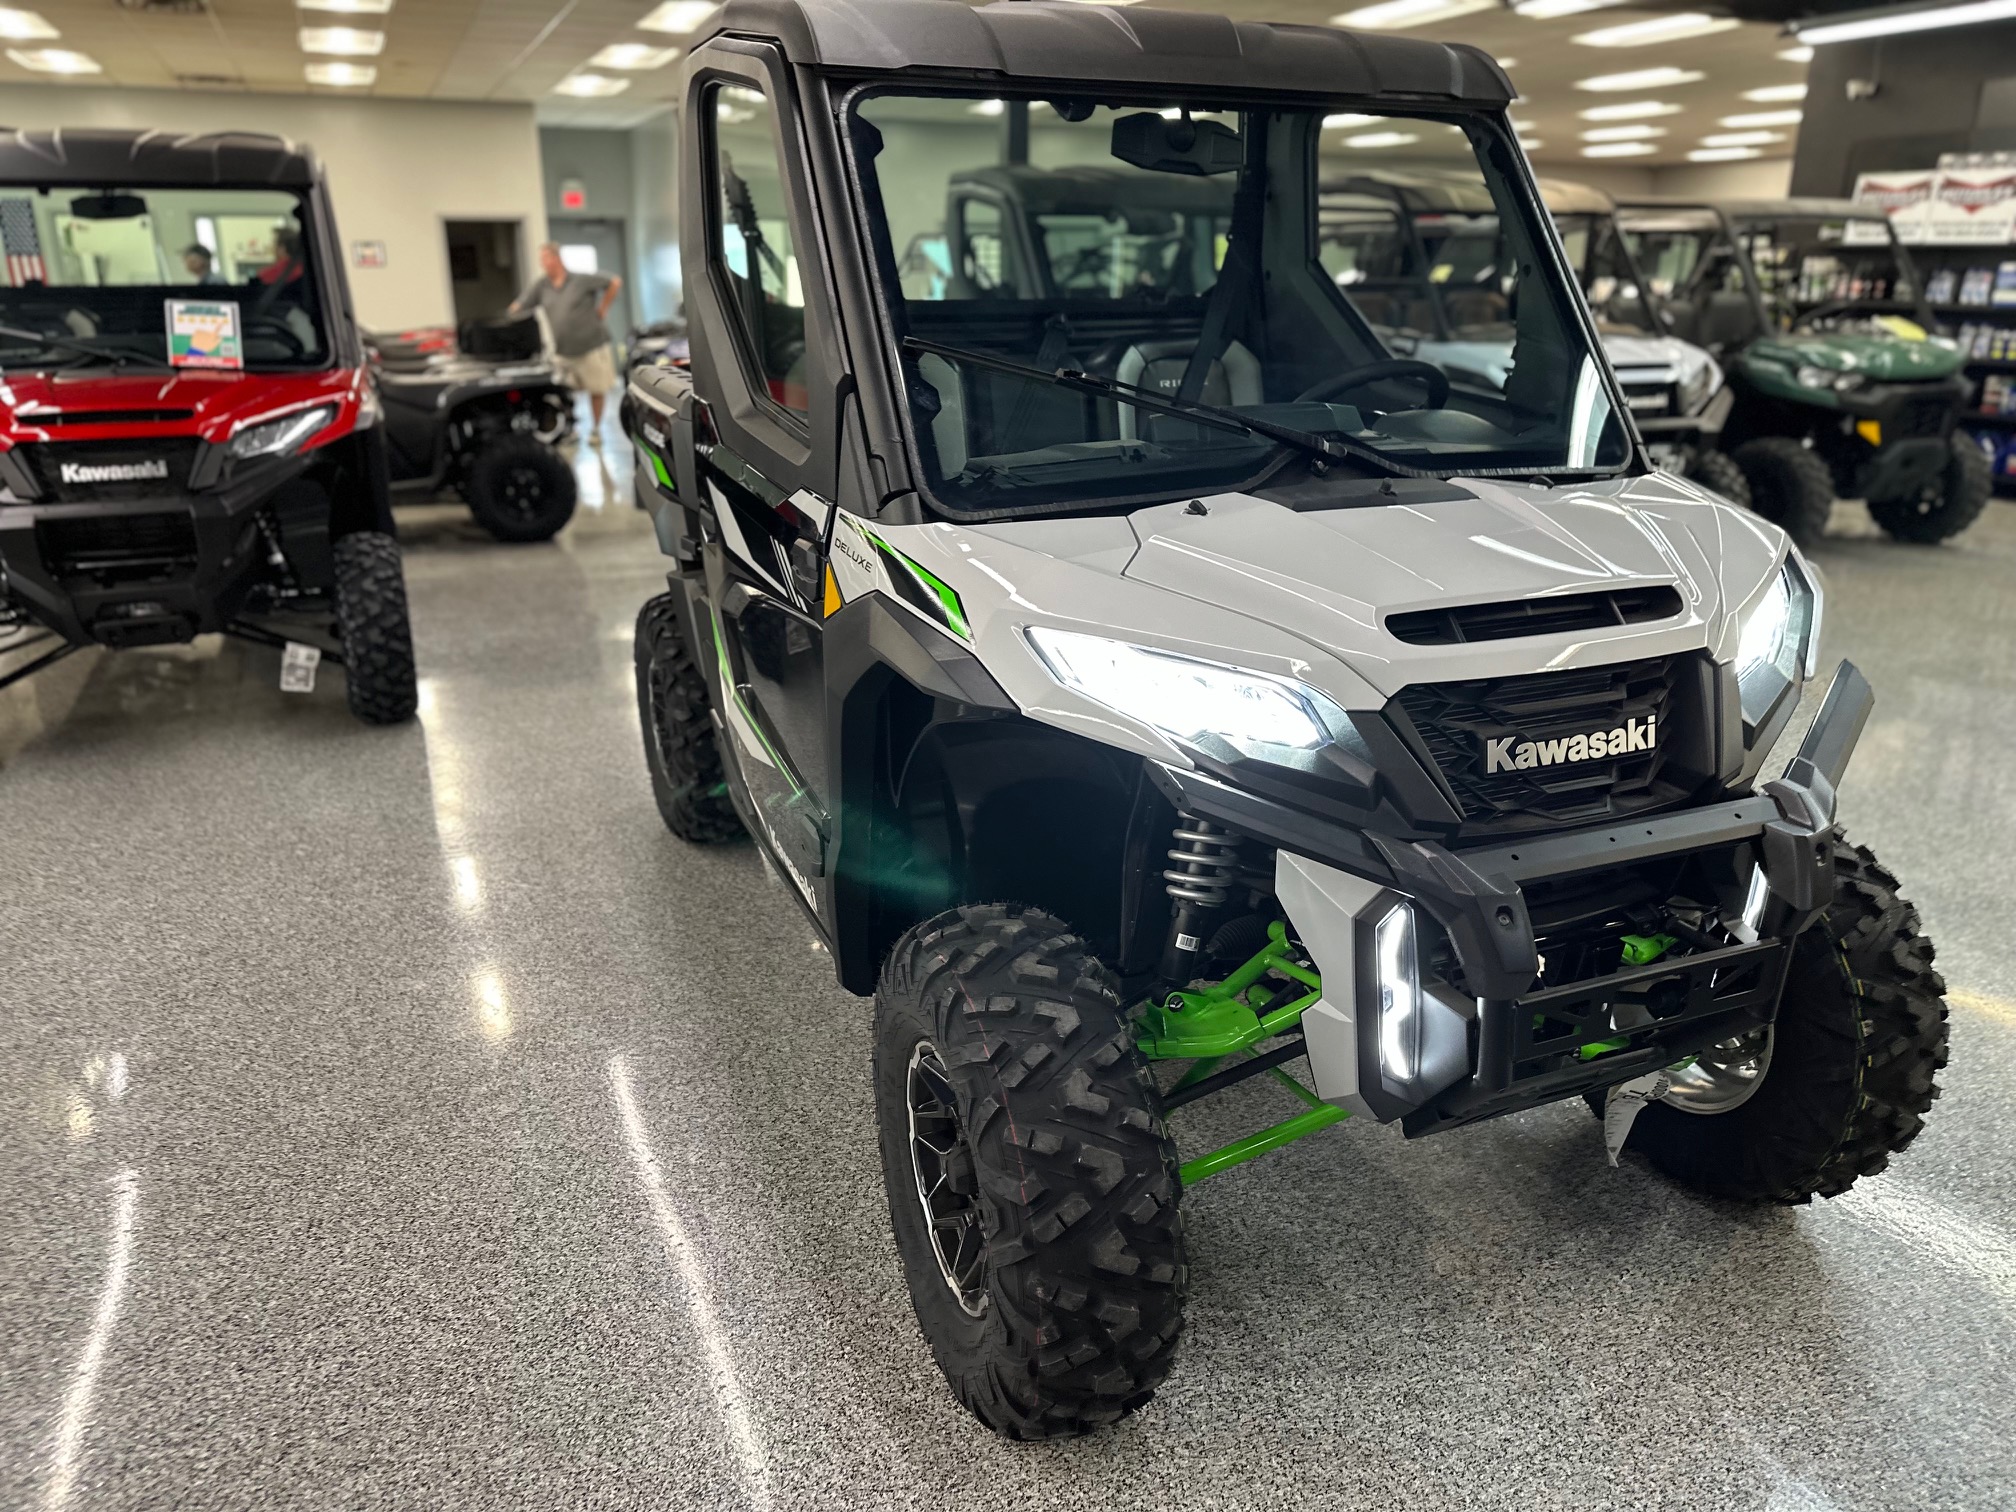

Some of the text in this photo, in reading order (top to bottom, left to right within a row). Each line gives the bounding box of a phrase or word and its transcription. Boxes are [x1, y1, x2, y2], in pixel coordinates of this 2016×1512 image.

[61, 459, 168, 483] Kawasaki
[834, 537, 873, 573] DELUXE
[1487, 714, 1656, 774] Kawasaki
